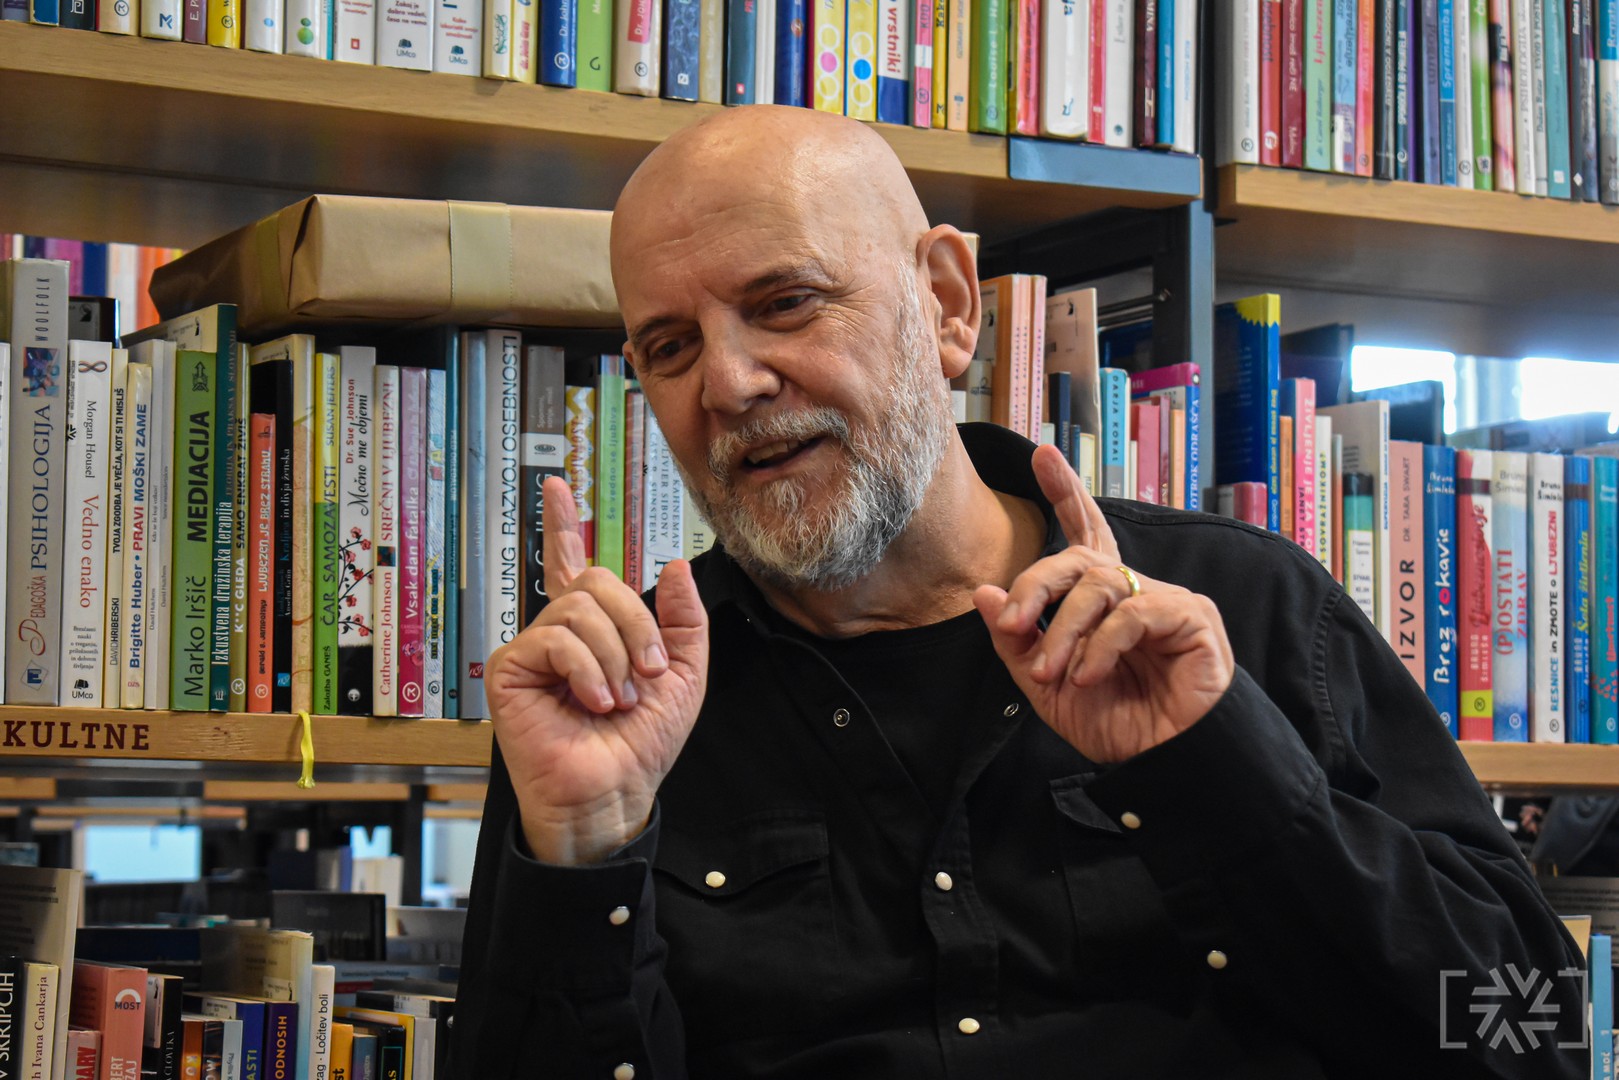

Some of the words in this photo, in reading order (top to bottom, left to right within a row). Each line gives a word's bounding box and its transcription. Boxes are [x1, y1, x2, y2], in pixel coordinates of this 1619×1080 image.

[887, 7, 902, 73] vrstniki
[1440, 8, 1454, 89] Sprememba
[988, 40, 997, 89] Louise
[34, 277, 50, 342] WOOLFOLK
[113, 388, 124, 417] MISLIŠ
[325, 366, 338, 406] JEFFERS
[345, 379, 355, 422] Johnson
[502, 335, 518, 452] OSEBNOSTI
[1112, 375, 1120, 415] DARJA
[83, 399, 97, 440] Morgan
[135, 403, 147, 448] ZAME
[234, 417, 247, 451] ŽIVIŠ
[325, 408, 335, 447] SUSAN
[346, 427, 354, 446] Sue
[350, 394, 372, 435] objemi
[381, 382, 397, 460] LJUBEZNI
[1189, 398, 1200, 461] ODRAŠČA
[1303, 397, 1315, 474] ŽIVLJENJE
[83, 443, 97, 479] Housel
[114, 435, 122, 452] KOT
[345, 448, 354, 464] Dr.
[357, 439, 367, 458] me
[1111, 422, 1120, 462] KOBAL
[112, 453, 124, 481] VEČJA,
[133, 452, 146, 502] MOŠKI
[186, 410, 210, 543] MEDIACIJA
[236, 453, 247, 506] ENKRAT
[279, 448, 291, 481] ženska
[381, 465, 393, 475] V
[607, 467, 617, 502] vedno
[1190, 464, 1200, 509] OTROK
[1402, 456, 1412, 492] SWART
[30, 403, 55, 571] PSIHOLOGIJA
[114, 482, 122, 492] JE
[279, 483, 293, 507] divja
[346, 464, 370, 517] Močno
[501, 457, 518, 536] RAZVOJ
[1402, 495, 1411, 521] TARA
[80, 494, 99, 551] Vedno
[113, 494, 122, 526] ZGODBA
[132, 506, 145, 552] PRAVI
[213, 501, 234, 545] terapija
[235, 510, 247, 549] SAMO
[281, 508, 290, 518] in
[321, 465, 337, 583] SAMOZAVESTI
[379, 481, 394, 541] SREČNI
[405, 486, 420, 540] fatalka
[649, 482, 658, 543] SUNSTEIN
[660, 492, 669, 538] SIBONY
[671, 478, 681, 549] KAHNEMAN
[1304, 501, 1314, 522] ZA
[112, 527, 121, 554] TVOJA
[405, 545, 419, 576] dan
[1547, 510, 1559, 576] LJUBEZNI
[79, 556, 98, 608] enako
[130, 563, 143, 609] Huber
[211, 548, 232, 602] družinska
[234, 557, 246, 599] GLEDA
[501, 546, 517, 602] JUNG
[18, 576, 47, 656] PEDAGOŠKA
[184, 575, 207, 619] Iršič
[319, 591, 336, 626] ČAR
[380, 571, 395, 630] Johnson
[405, 580, 419, 619] Vsak
[1399, 559, 1416, 660] IZVOR
[1496, 548, 1514, 656] (P)OSTATI
[1549, 590, 1558, 637] ZMOTE
[129, 613, 144, 669] Brigitte
[210, 606, 230, 665] Izkustvena
[501, 607, 516, 644] C.G.
[1549, 640, 1558, 653] in
[183, 626, 206, 697] Marko
[322, 645, 331, 677] GANEŠ
[379, 629, 392, 696] Catherine
[1433, 626, 1453, 684] Brez
[71, 690, 94, 700] UMco
[323, 680, 332, 710] Založba
[1549, 657, 1560, 712] RESNICE
[2, 719, 150, 751] KULTNE
[34, 976, 49, 1031] Cankarja
[114, 1001, 142, 1010] MOST
[316, 993, 329, 1014] boli
[31, 1034, 44, 1067] Ivana
[274, 1015, 288, 1080] ODNOSIH
[314, 1016, 329, 1055] Ločitev
